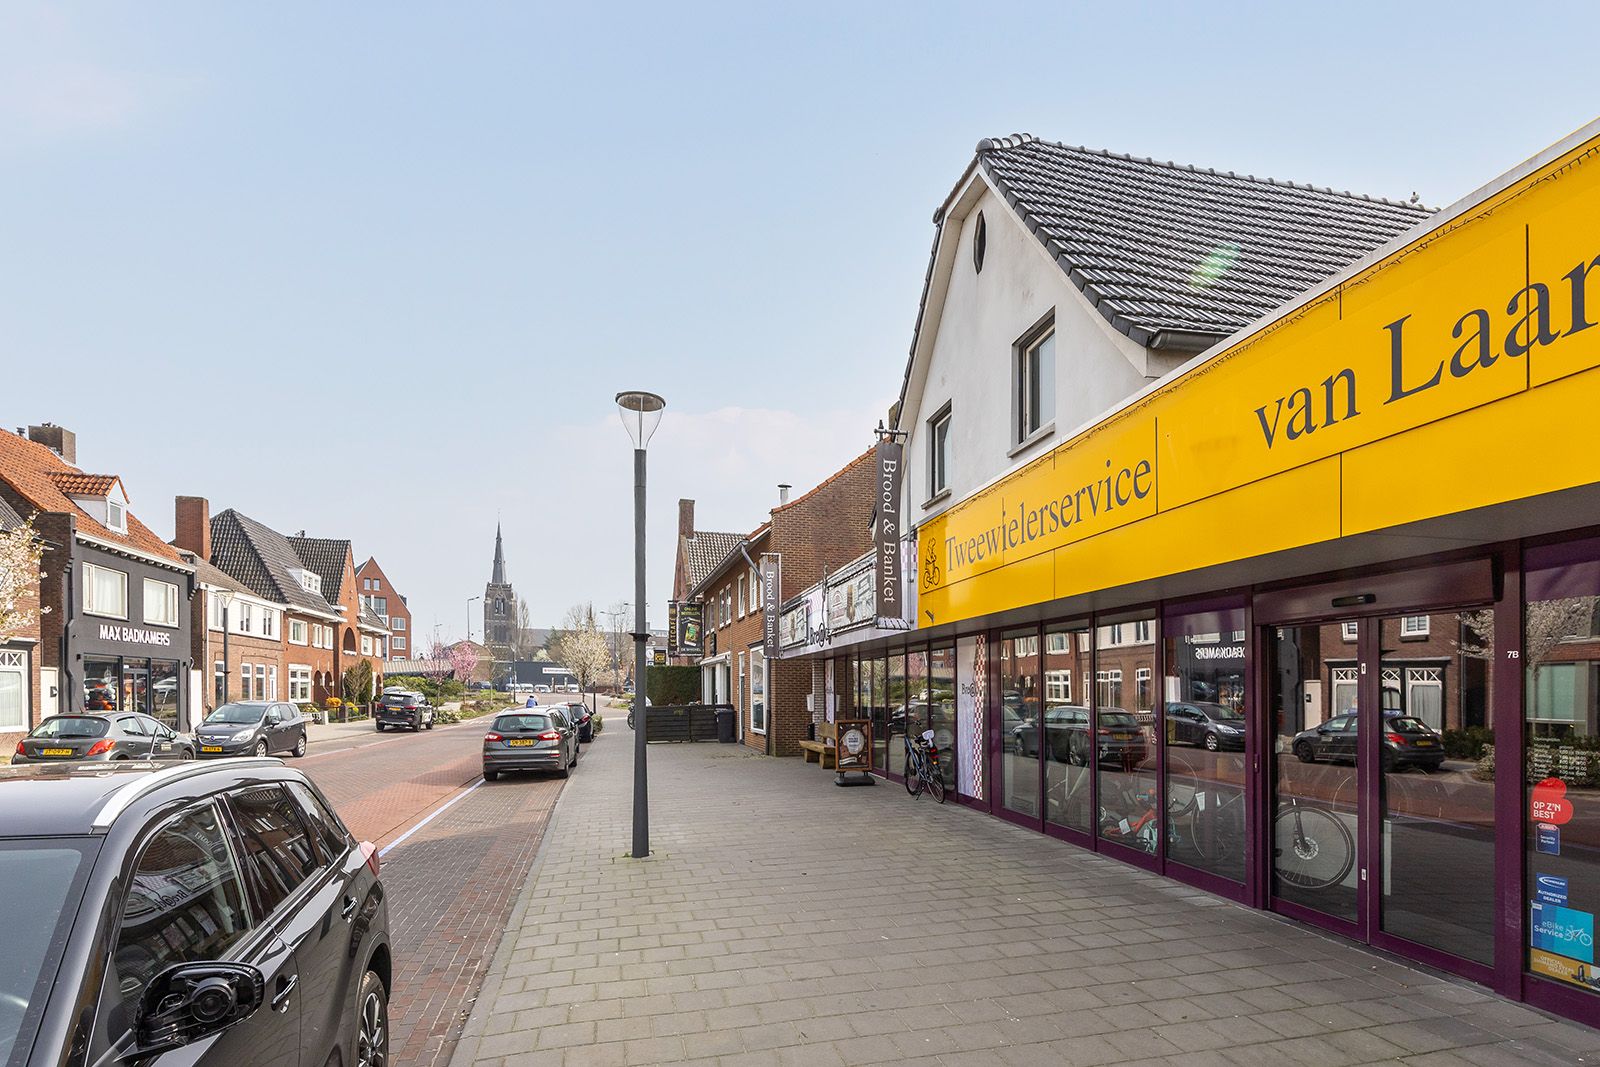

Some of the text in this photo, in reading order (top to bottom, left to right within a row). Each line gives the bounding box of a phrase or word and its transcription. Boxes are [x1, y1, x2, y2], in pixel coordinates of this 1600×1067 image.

[945, 459, 1152, 572] Tweewielerservice
[1254, 368, 1361, 449] van
[882, 458, 897, 603] Brood & Banket
[766, 571, 776, 648] Brood & Banket
[99, 624, 171, 647] MAX BADKAMERS
[1506, 650, 1519, 659] 7B
[1533, 801, 1561, 812] OP Z'N
[1533, 810, 1556, 820] BEST
[1537, 889, 1568, 900] AUTHORIZED
[1543, 895, 1562, 904] DEALER
[1533, 924, 1564, 939] Service
[1542, 920, 1564, 932] eBike
